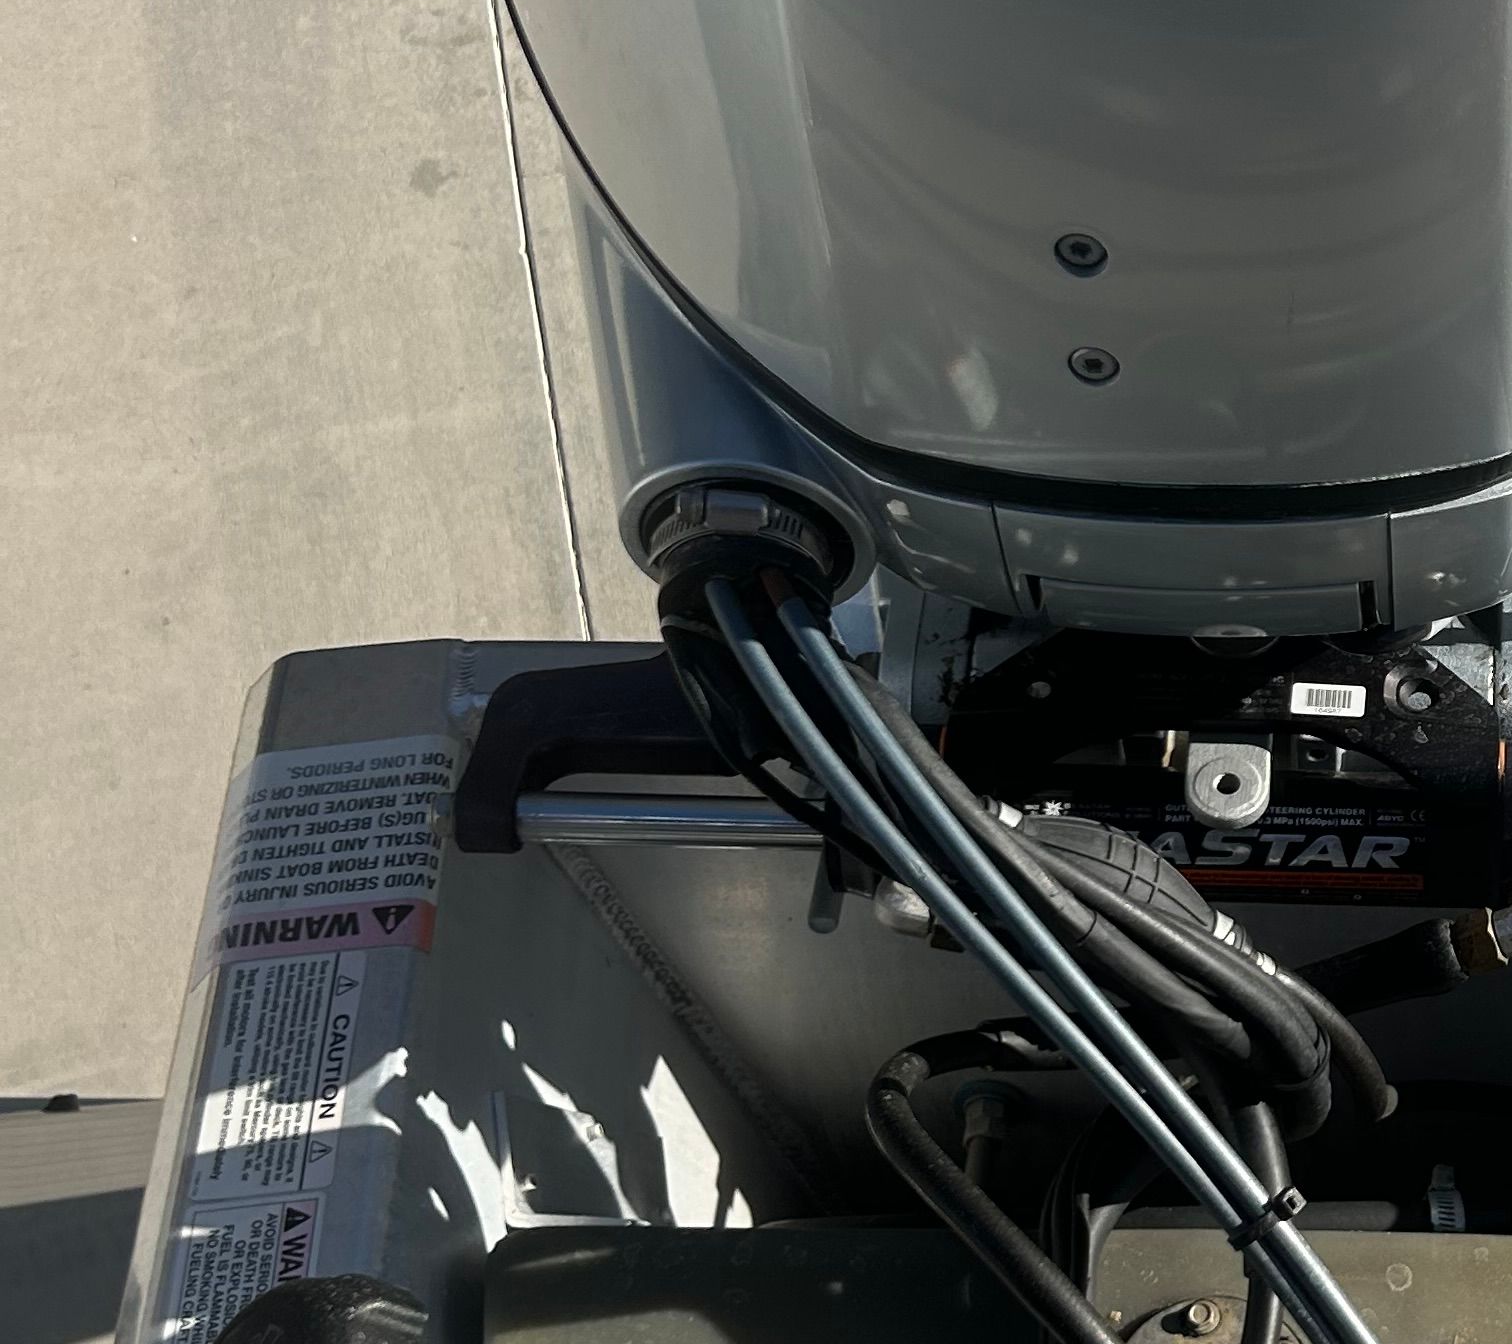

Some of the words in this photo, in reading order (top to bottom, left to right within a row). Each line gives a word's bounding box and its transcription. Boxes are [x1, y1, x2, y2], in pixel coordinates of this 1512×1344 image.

[285, 758, 365, 780] PERIODS.
[369, 753, 416, 771] LONG
[420, 752, 453, 769] FOR
[297, 774, 401, 798] WINTERIZING
[403, 772, 450, 787] WHEN
[270, 785, 294, 801] OR
[323, 793, 396, 814] REMOVE
[399, 789, 436, 805] OAT.
[264, 801, 319, 821] DRAIN
[376, 808, 426, 829] UG(S)
[1315, 807, 1365, 816] CYLINDER
[236, 822, 300, 845] LAUNC
[304, 814, 372, 837] BEFORE
[252, 840, 326, 862] TIGHTEN
[330, 836, 368, 853] AND
[1150, 829, 1411, 869] ASTAR
[327, 855, 379, 874] FROM
[384, 851, 439, 867] DEATH
[275, 861, 322, 879] BOAT
[383, 872, 436, 888] AVOID
[233, 884, 298, 904] INJURY
[302, 875, 379, 896] SERIOUS
[218, 911, 362, 950] WARNIN
[233, 969, 244, 989] after
[246, 967, 258, 987] Test
[244, 988, 254, 1000] all
[223, 991, 240, 1047] installation.
[237, 1002, 252, 1036] motors
[235, 1038, 246, 1052] for
[318, 1013, 351, 1119] CAUTION
[223, 1055, 243, 1115] interference
[209, 1118, 230, 1179] immediately
[250, 1219, 264, 1237] OR
[262, 1212, 279, 1250] AVOID
[206, 1229, 221, 1249] NO
[218, 1223, 235, 1256] FUEL
[233, 1239, 247, 1258] OR
[184, 1242, 204, 1297] FUELING
[216, 1260, 228, 1270] IS
[243, 1241, 261, 1282] DEATH
[196, 1251, 216, 1312] SMOKING
[256, 1255, 273, 1292] SERIO
[222, 1262, 243, 1328] EXPLOSIO
